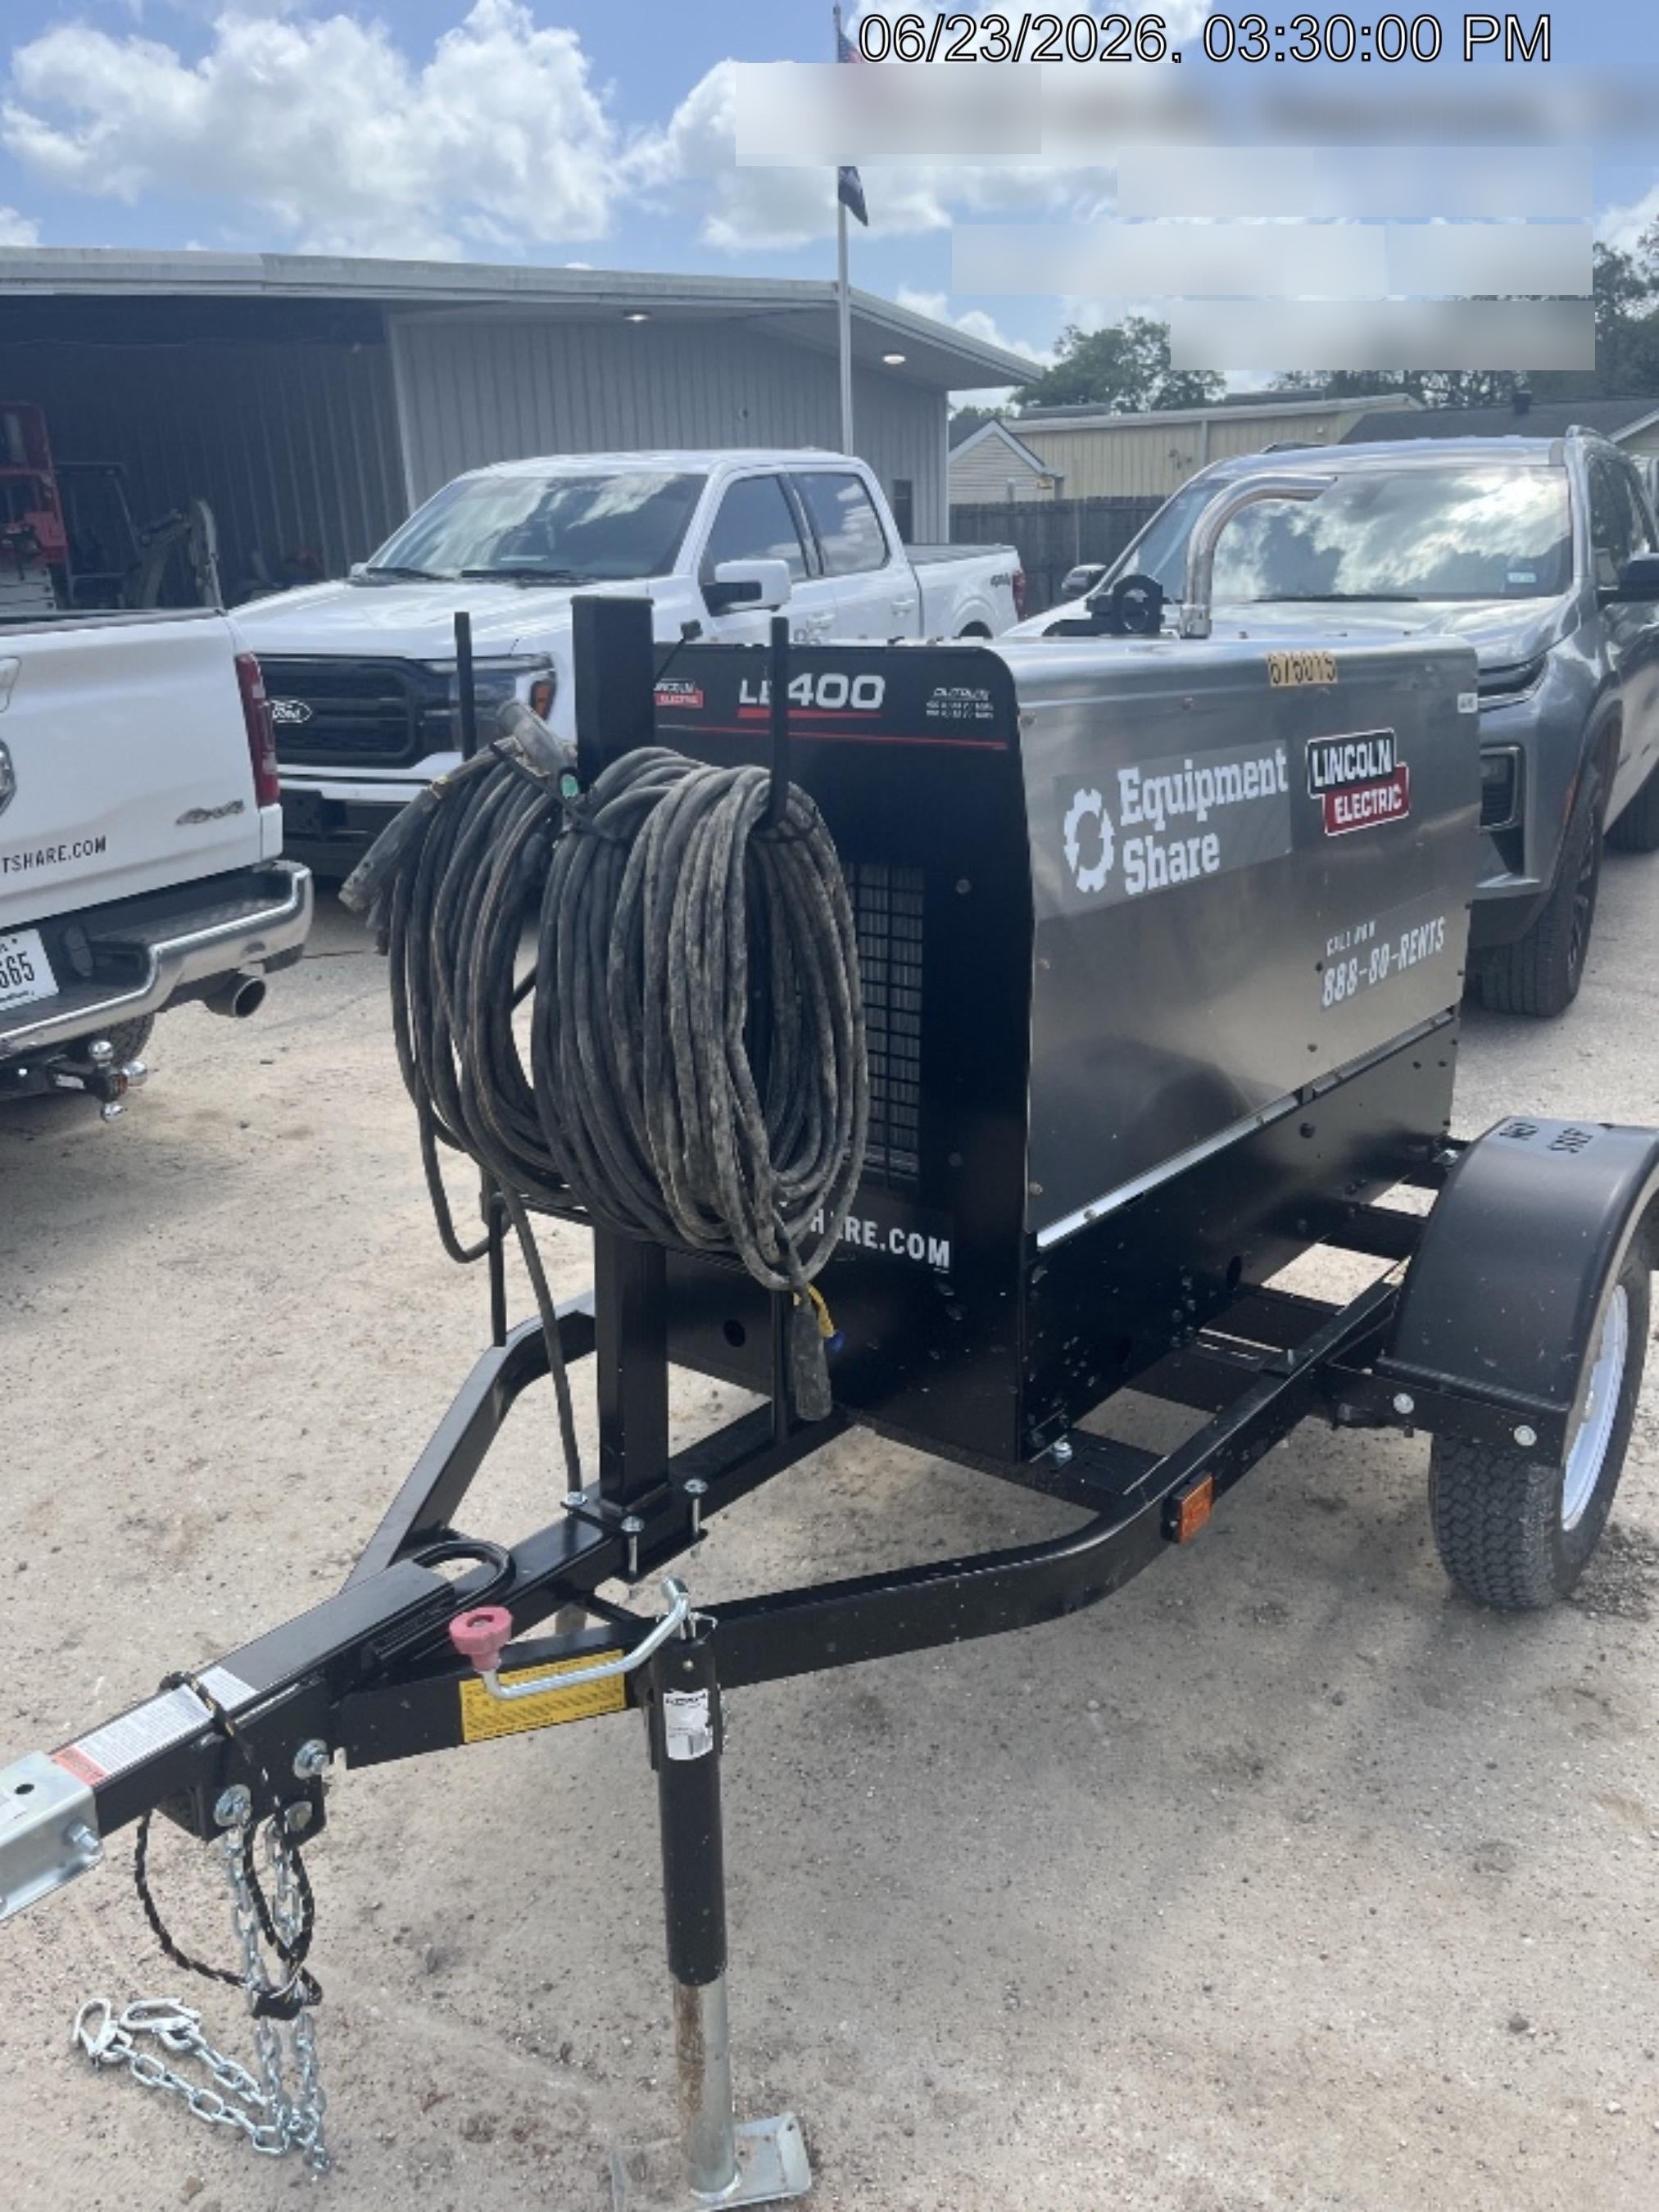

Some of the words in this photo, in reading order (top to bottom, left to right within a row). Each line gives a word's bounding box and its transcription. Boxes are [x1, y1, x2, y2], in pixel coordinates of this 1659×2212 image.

[1117, 747, 1289, 832] Equipment
[1312, 739, 1392, 786] LINCOLN
[1334, 784, 1402, 823] ELECTRIC
[2, 835, 107, 874] TSHARE.COM
[1122, 833, 1220, 895] Share
[1322, 916, 1446, 1008] 888-80-RENTS
[810, 1208, 950, 1268] HRE.COM
